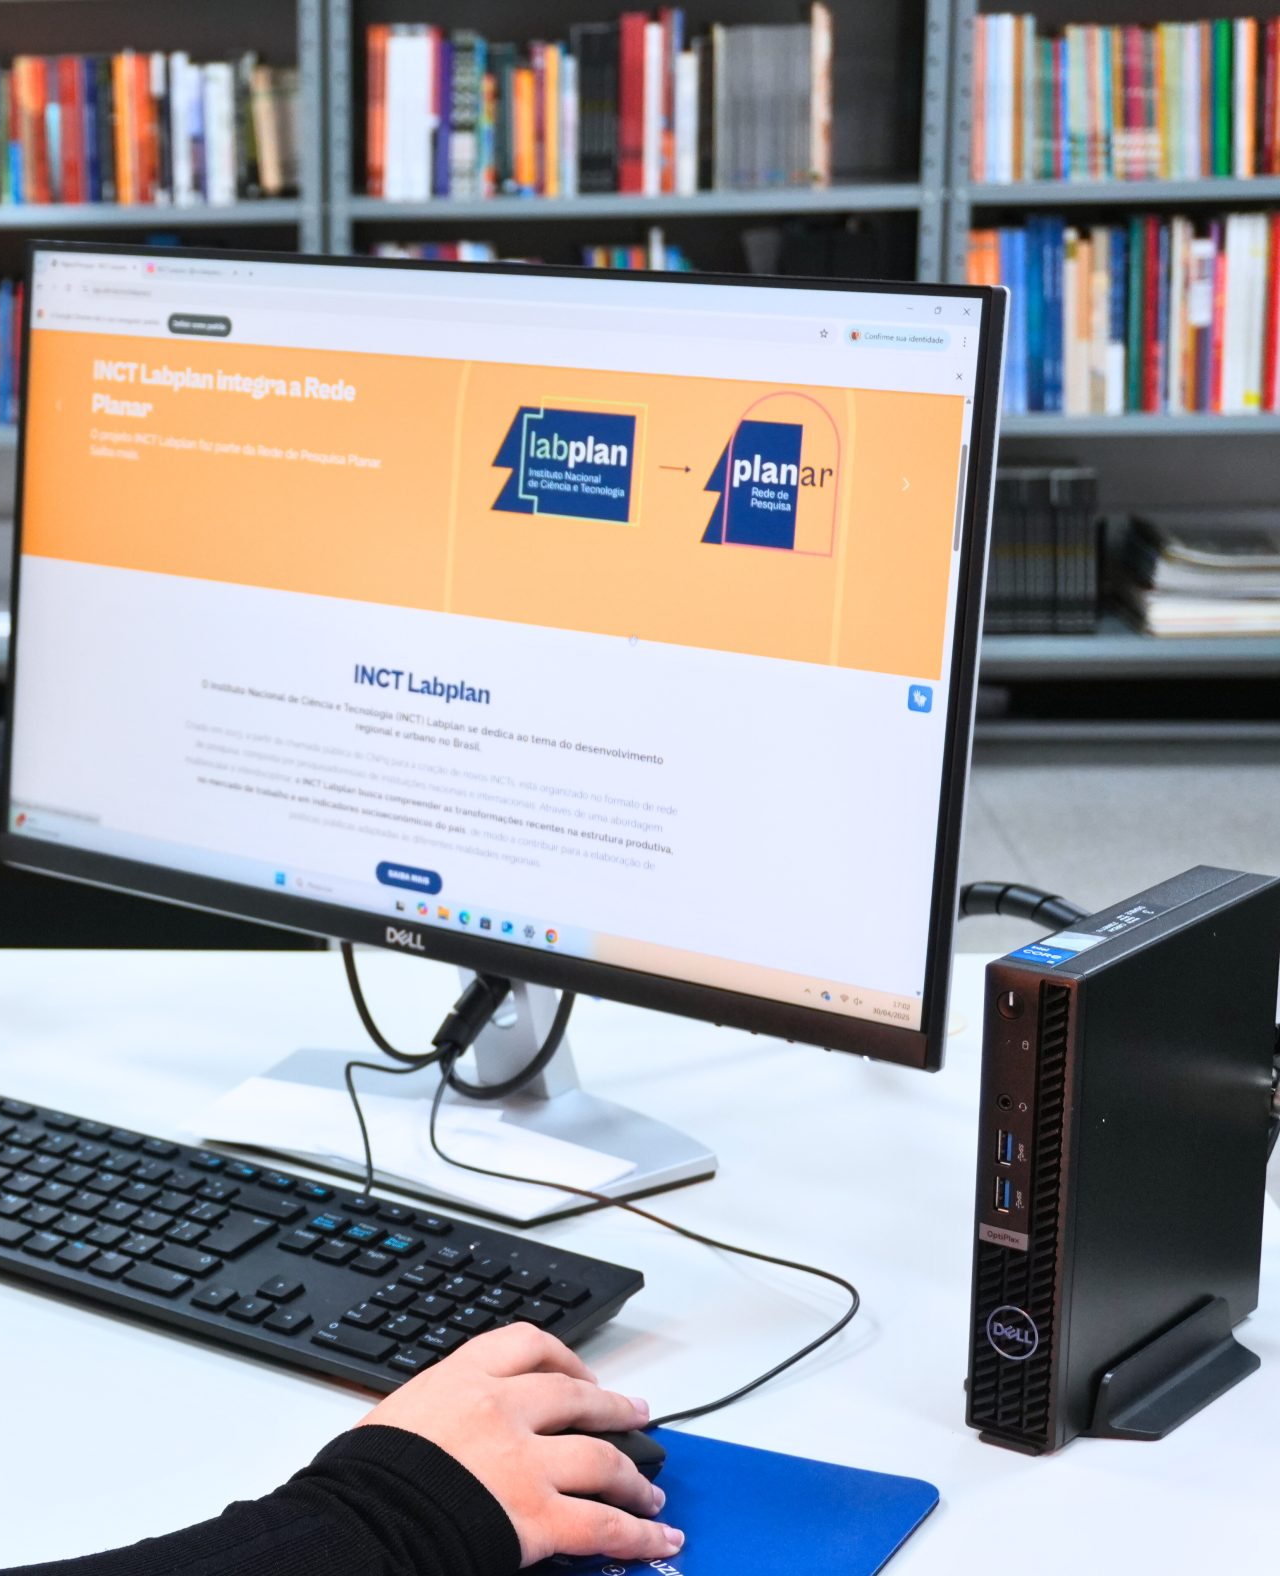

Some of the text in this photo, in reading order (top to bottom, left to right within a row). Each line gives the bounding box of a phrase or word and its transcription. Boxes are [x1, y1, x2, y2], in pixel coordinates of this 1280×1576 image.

[864, 332, 944, 344] Confirme sua identidade
[93, 359, 356, 402] INCT Labplan integra a Rede
[91, 392, 153, 418] Planar
[134, 432, 160, 445] INCT
[258, 444, 284, 458] Rede
[300, 448, 346, 466] Pesquisa
[529, 430, 628, 468] labplan
[528, 468, 602, 484] Instituto Nacional
[732, 454, 833, 488] planar
[528, 478, 625, 499] de Ciência e Tecnologia
[751, 486, 790, 500] Rede de
[750, 498, 792, 512] Pesquisa
[354, 663, 491, 705] INCT Labplan
[248, 686, 285, 702] Nacional
[288, 693, 299, 704] de
[300, 695, 334, 710] Ciência
[336, 703, 341, 711] e
[344, 702, 393, 721] Tecnologia
[396, 711, 424, 728] (INCT)
[426, 716, 465, 732] Labplan
[467, 725, 478, 734] se
[480, 725, 514, 740] dedica
[516, 734, 528, 743] ao
[530, 733, 556, 747] tema
[560, 738, 572, 750] do
[574, 740, 664, 765] desenvolvimento
[356, 723, 393, 736] regional
[395, 730, 400, 738] e
[402, 730, 436, 744] urbano
[438, 737, 450, 746] no
[450, 766, 460, 776] de
[539, 784, 589, 799] organizado
[590, 793, 602, 802] no
[604, 793, 640, 808] formato
[642, 800, 654, 811] de
[656, 804, 678, 815] rede
[312, 795, 359, 813] indicadores
[361, 807, 433, 828] socioeconômicos
[435, 819, 446, 830] do
[518, 837, 558, 852] contribuir
[560, 846, 580, 856] para
[590, 850, 641, 869] elaboração
[643, 859, 656, 871] de
[358, 785, 382, 799] busca
[384, 793, 441, 810] compreender
[443, 804, 453, 812] as
[454, 804, 523, 826] transformações
[526, 820, 565, 834] recentes
[567, 827, 578, 836] na
[580, 830, 624, 845] estrutura
[625, 839, 674, 857] produtiva,
[574, 808, 586, 819] de
[588, 813, 608, 823] uma
[610, 815, 663, 833] abordagem
[385, 926, 426, 950] DELL
[986, 1230, 1020, 1244] OptiPlex
[993, 1322, 1032, 1344] DELL
